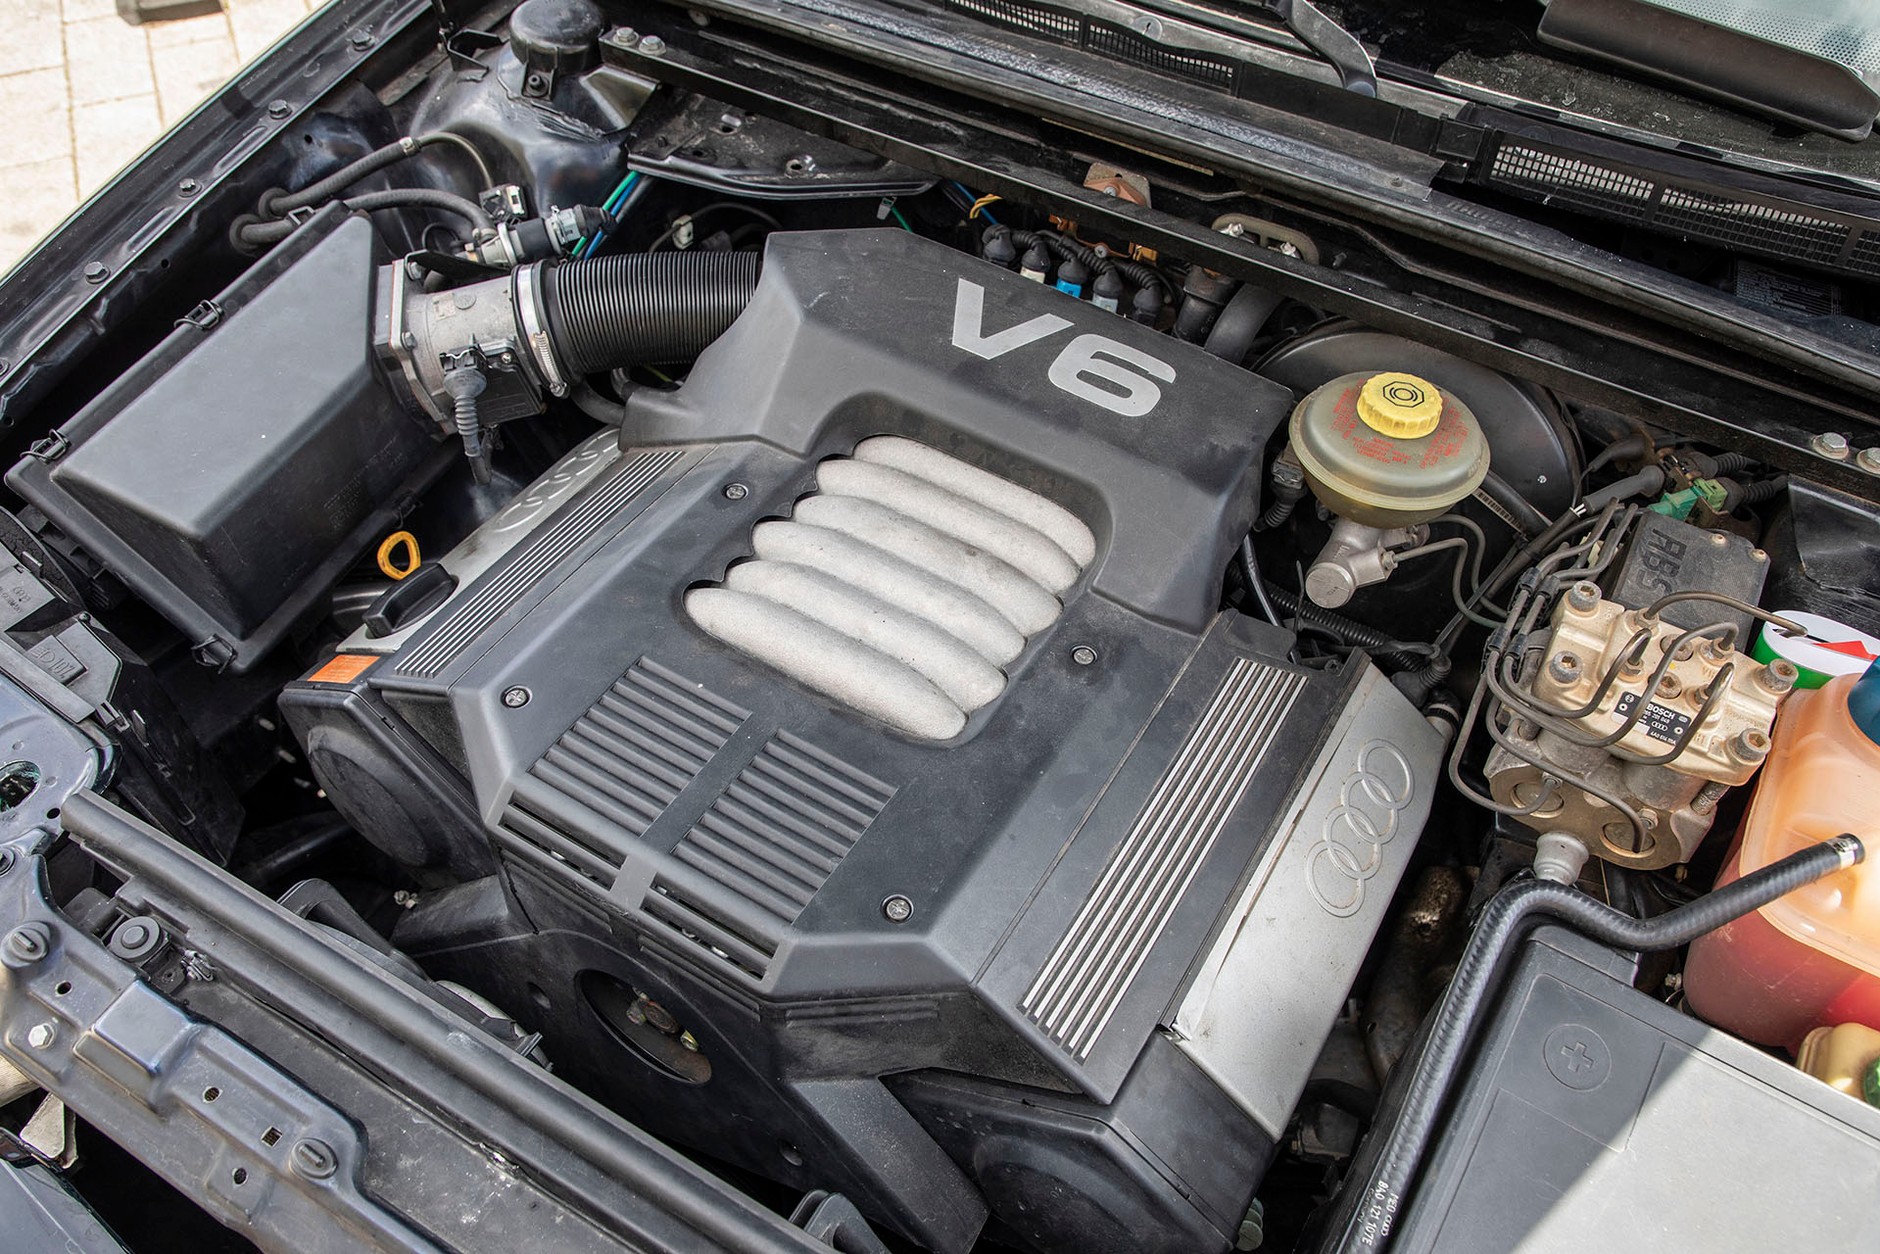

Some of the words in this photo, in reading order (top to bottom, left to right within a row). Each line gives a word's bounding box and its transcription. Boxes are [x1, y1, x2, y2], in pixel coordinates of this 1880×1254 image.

[952, 277, 1177, 417] V6
[1638, 528, 1687, 593] ABS
[1647, 703, 1676, 720] BOSCH
[1369, 1204, 1383, 1220] 121
[1361, 1222, 1378, 1247] 107E
